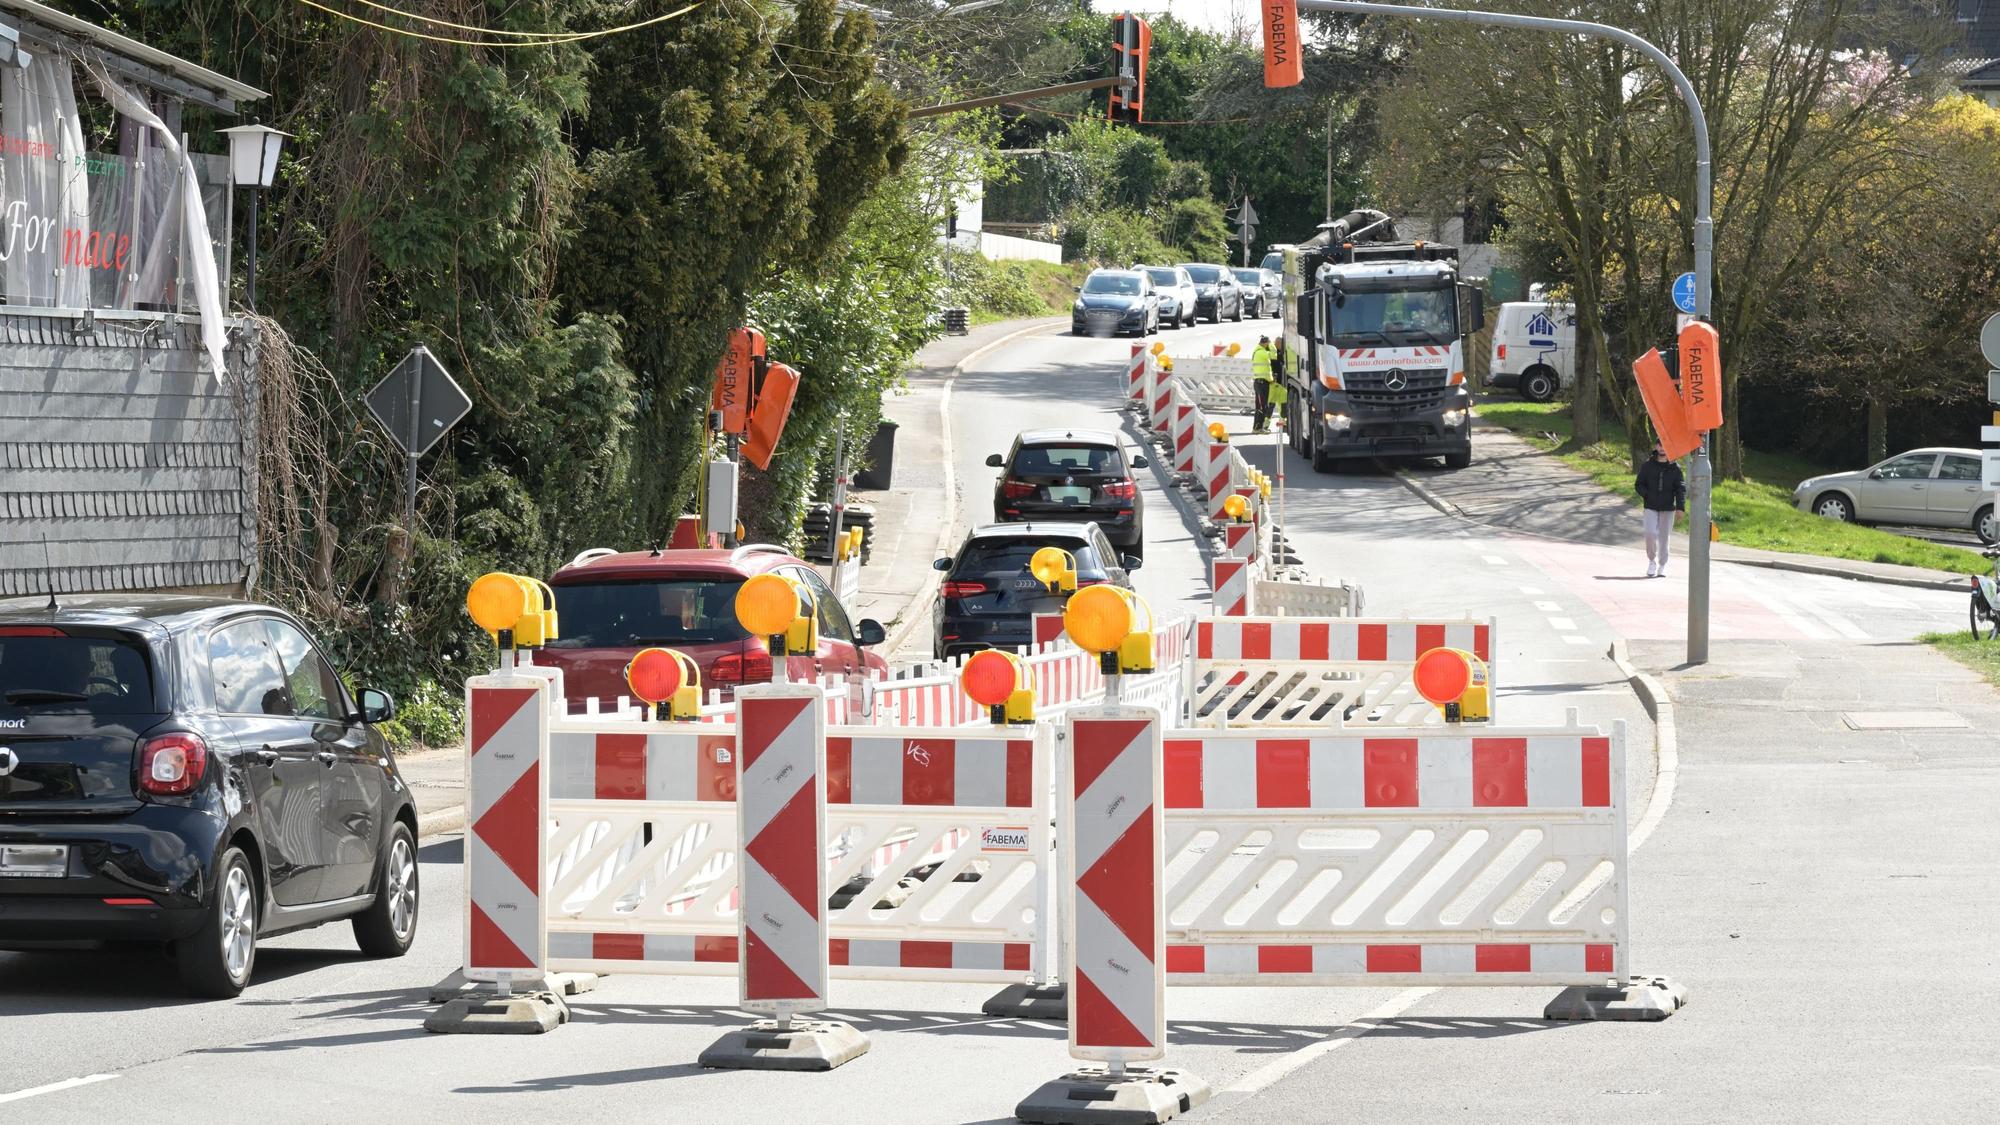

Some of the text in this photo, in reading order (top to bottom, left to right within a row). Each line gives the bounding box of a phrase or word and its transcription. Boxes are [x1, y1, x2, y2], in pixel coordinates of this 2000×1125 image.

[1271, 6, 1287, 66] FABEMA
[722, 351, 738, 408] FABEMA
[1689, 347, 1704, 405] FABEMA
[986, 834, 1026, 846] FABEMA
